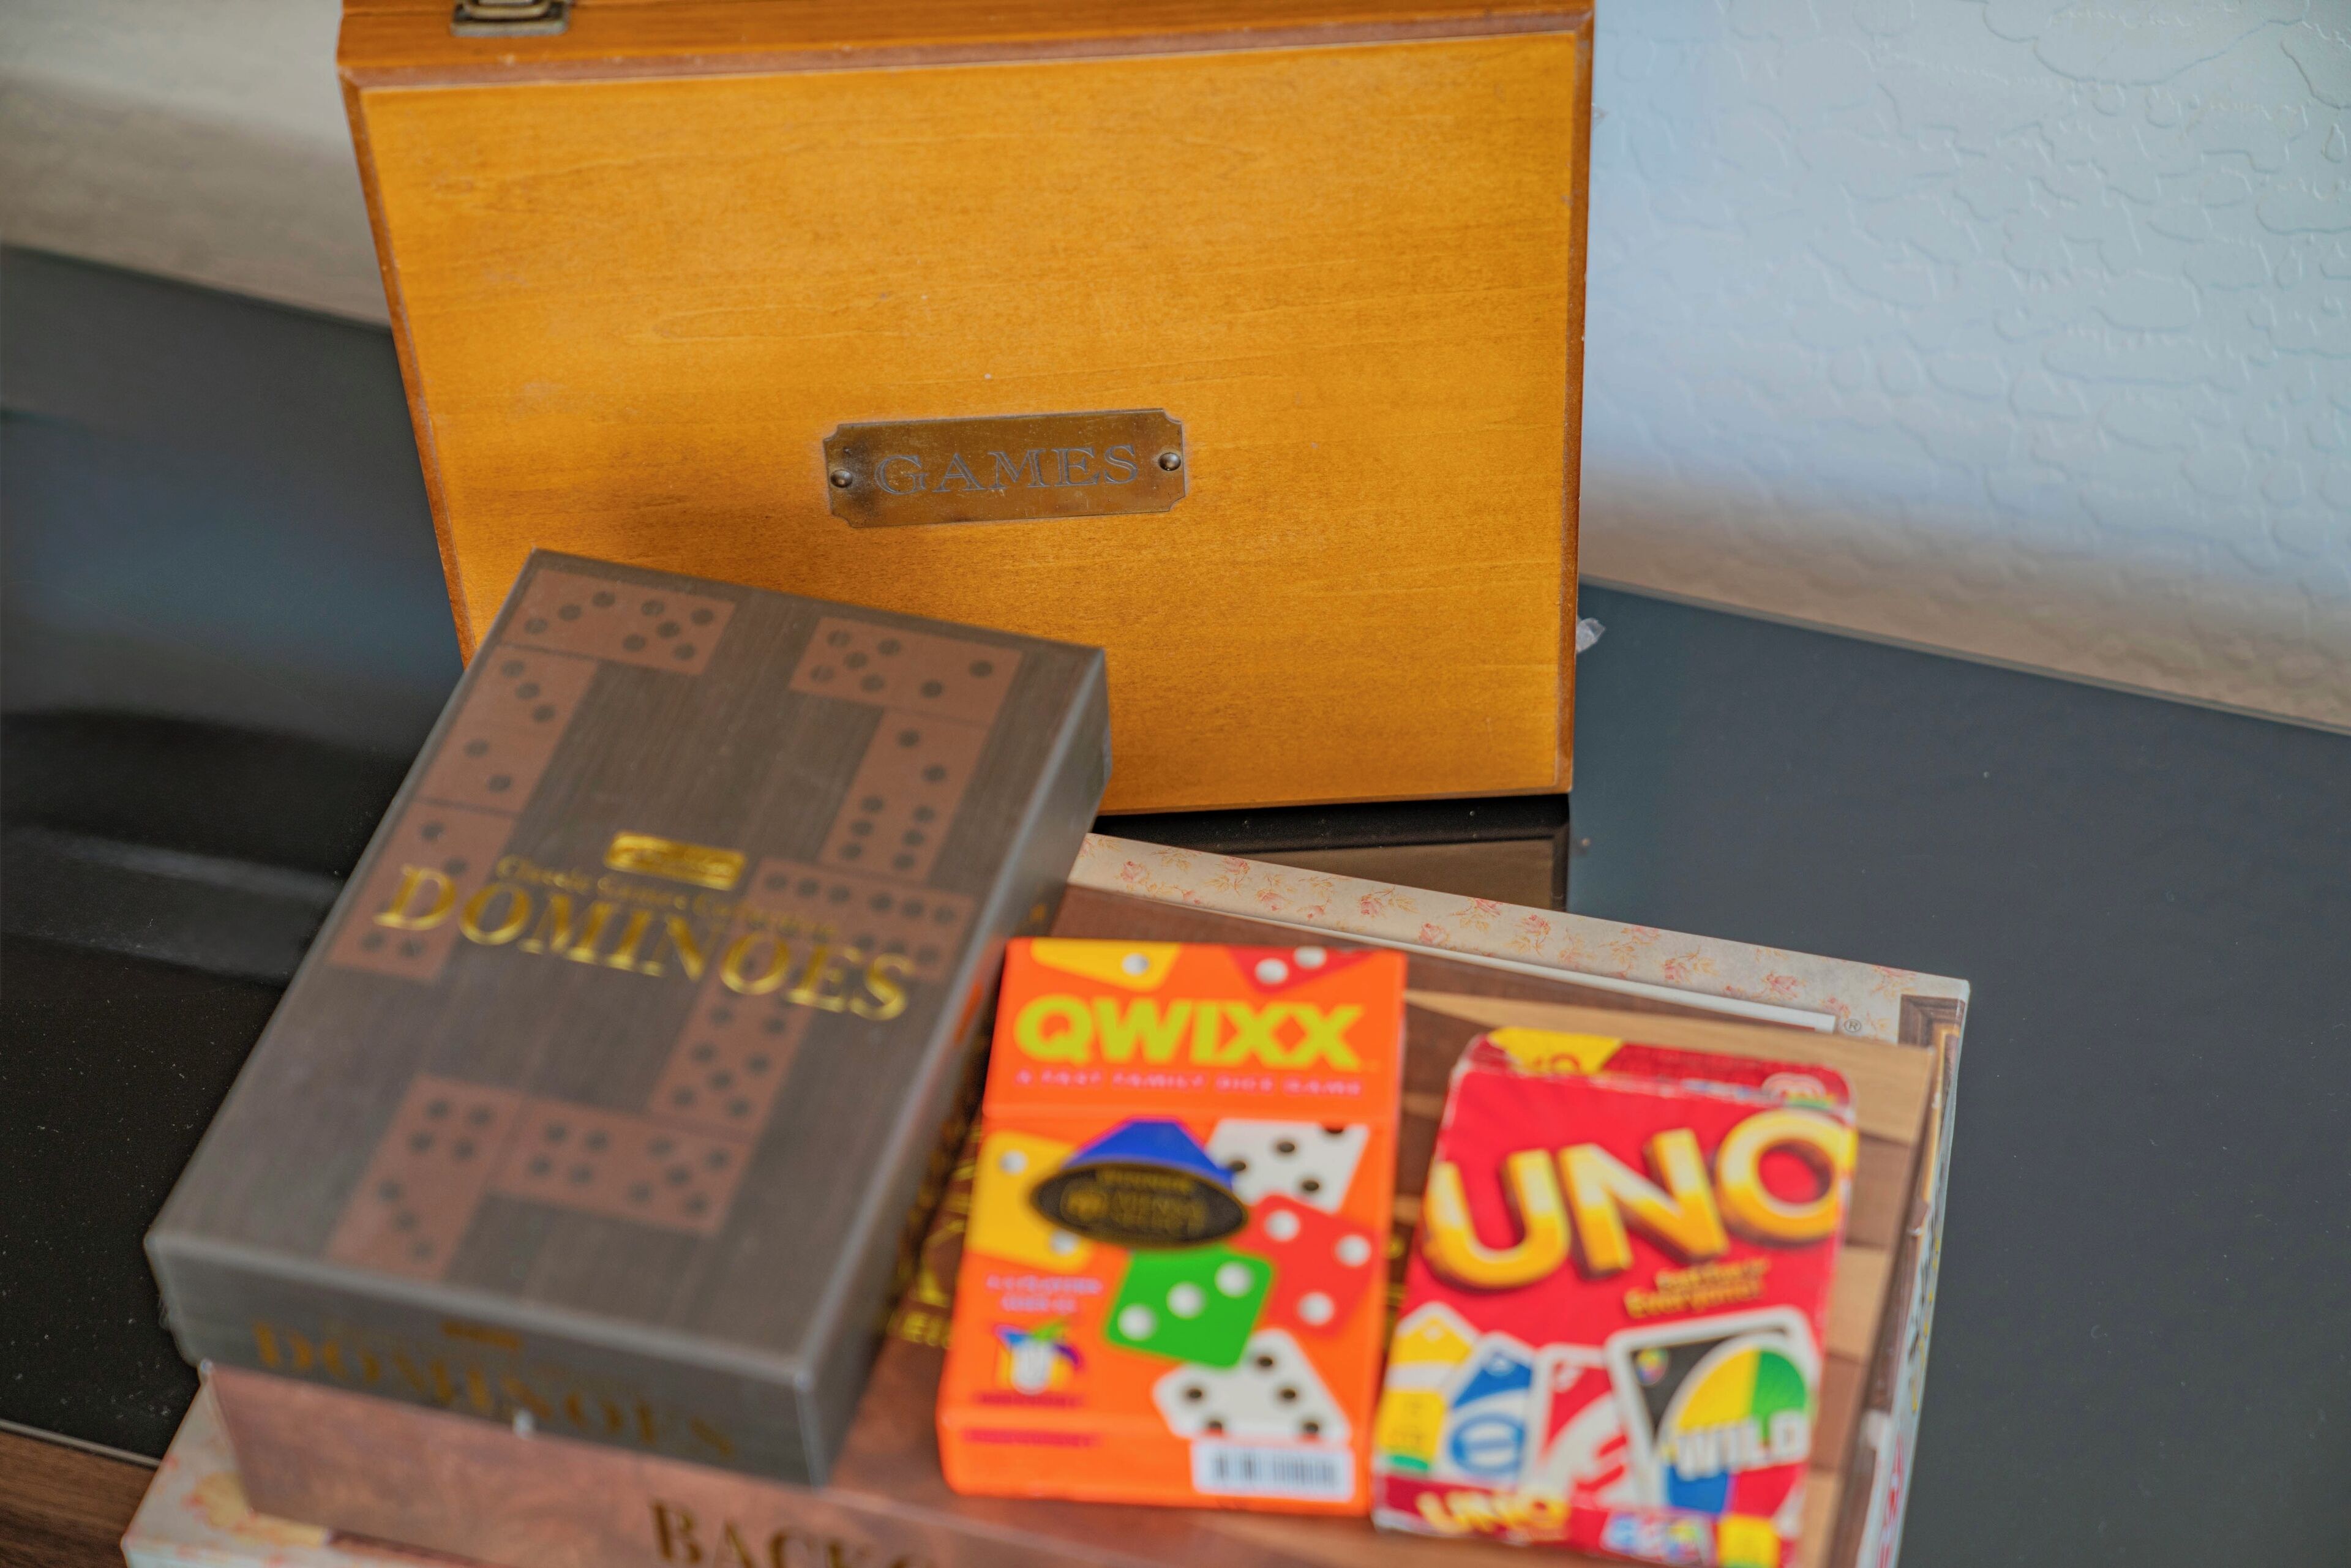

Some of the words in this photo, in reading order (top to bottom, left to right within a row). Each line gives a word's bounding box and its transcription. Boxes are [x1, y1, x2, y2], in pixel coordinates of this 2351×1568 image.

[874, 444, 1138, 495] GAMES
[373, 863, 913, 1021] DOMINOES
[1014, 993, 1364, 1071] QWIXX
[1423, 1108, 1859, 1290] UNO
[251, 1320, 733, 1455] DOMINOES
[1675, 1408, 1812, 1482] WILD
